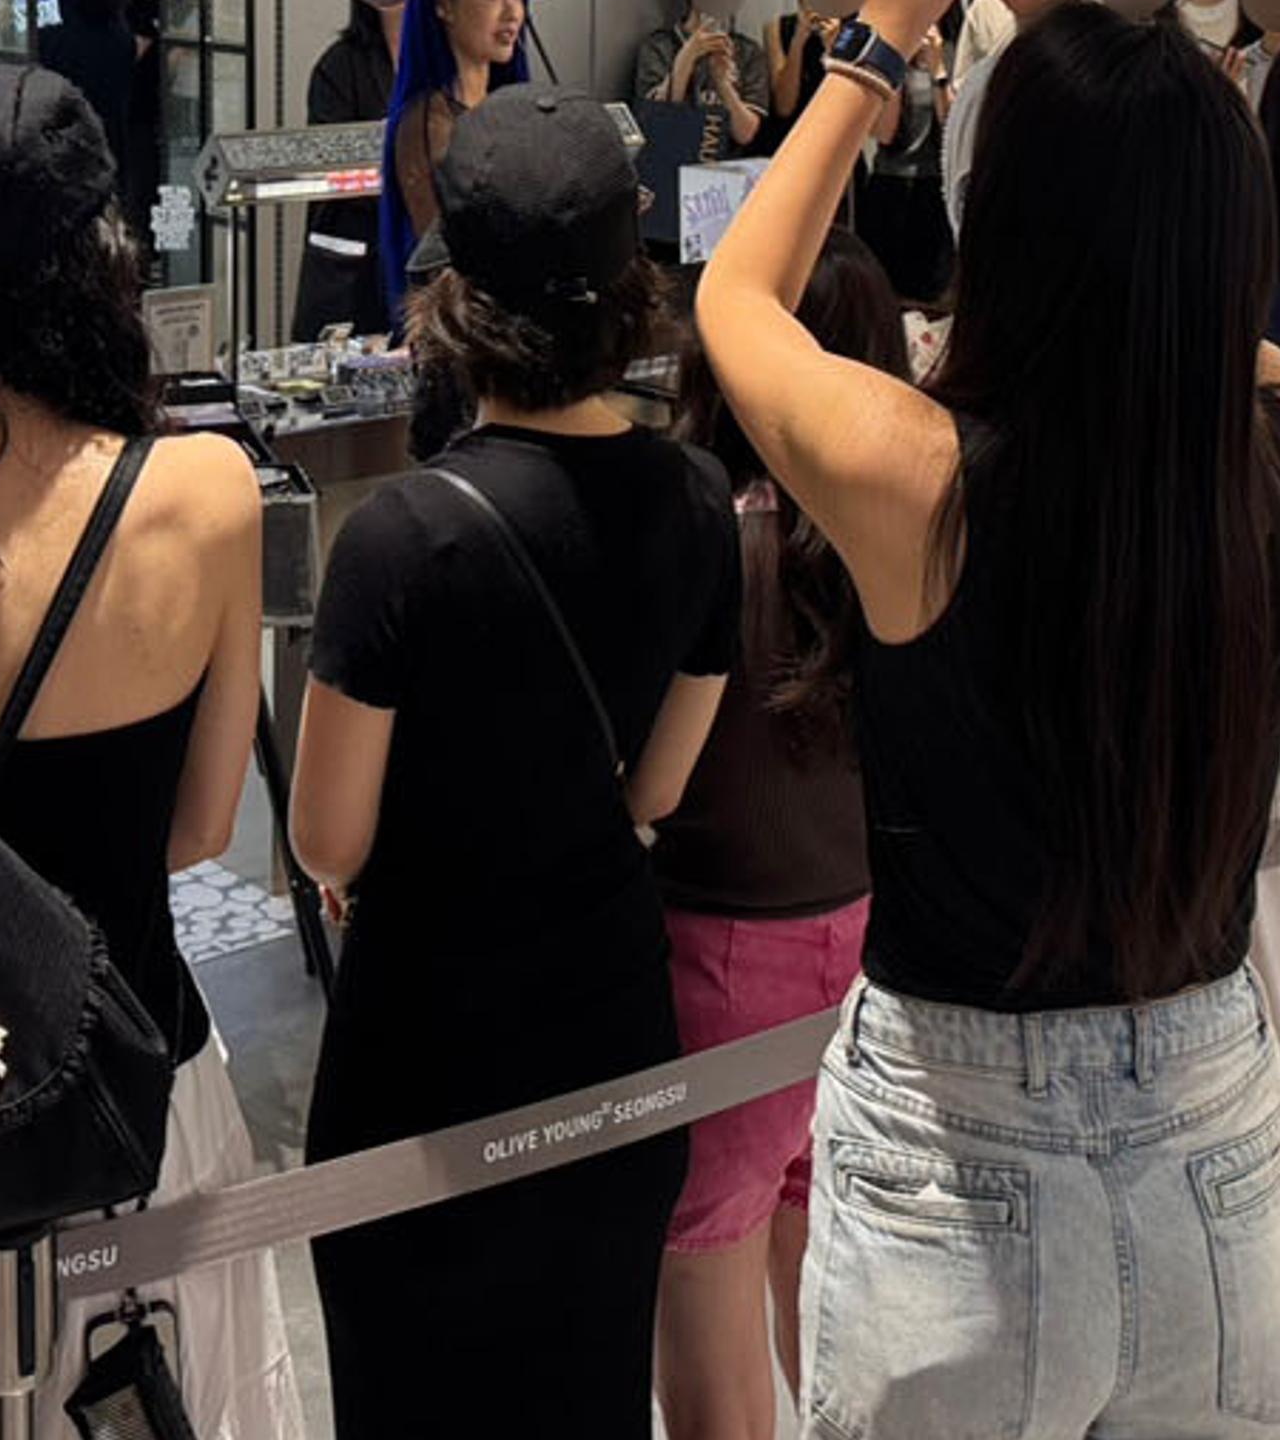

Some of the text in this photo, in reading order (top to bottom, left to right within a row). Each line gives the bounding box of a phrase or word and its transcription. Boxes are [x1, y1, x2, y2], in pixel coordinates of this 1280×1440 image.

[483, 1129, 539, 1163] OLIVE
[613, 1082, 687, 1123] SEONGSU
[57, 1244, 118, 1277] NGSU
